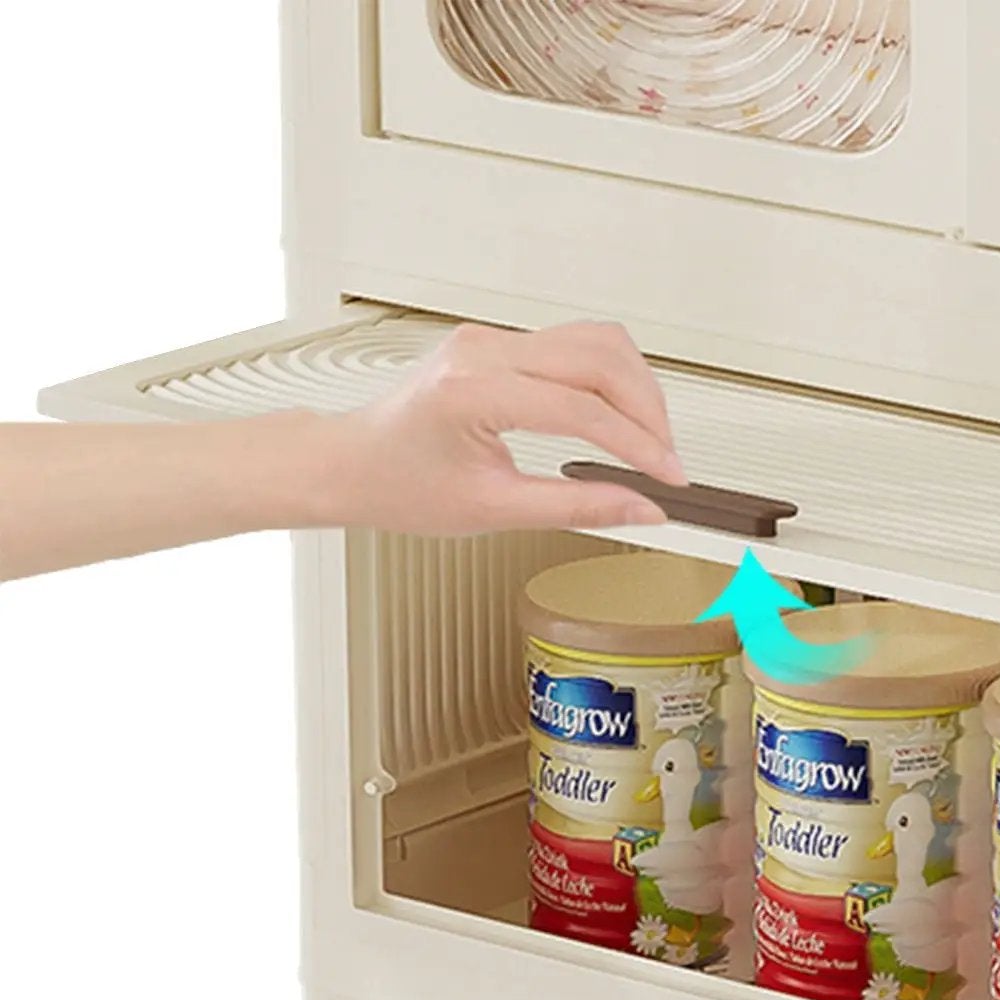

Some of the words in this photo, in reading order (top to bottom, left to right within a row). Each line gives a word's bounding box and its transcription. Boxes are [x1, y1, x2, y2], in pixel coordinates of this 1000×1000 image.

[539, 752, 616, 803] Toddler
[758, 728, 865, 791] Enfagrow
[768, 806, 849, 859] Toddler
